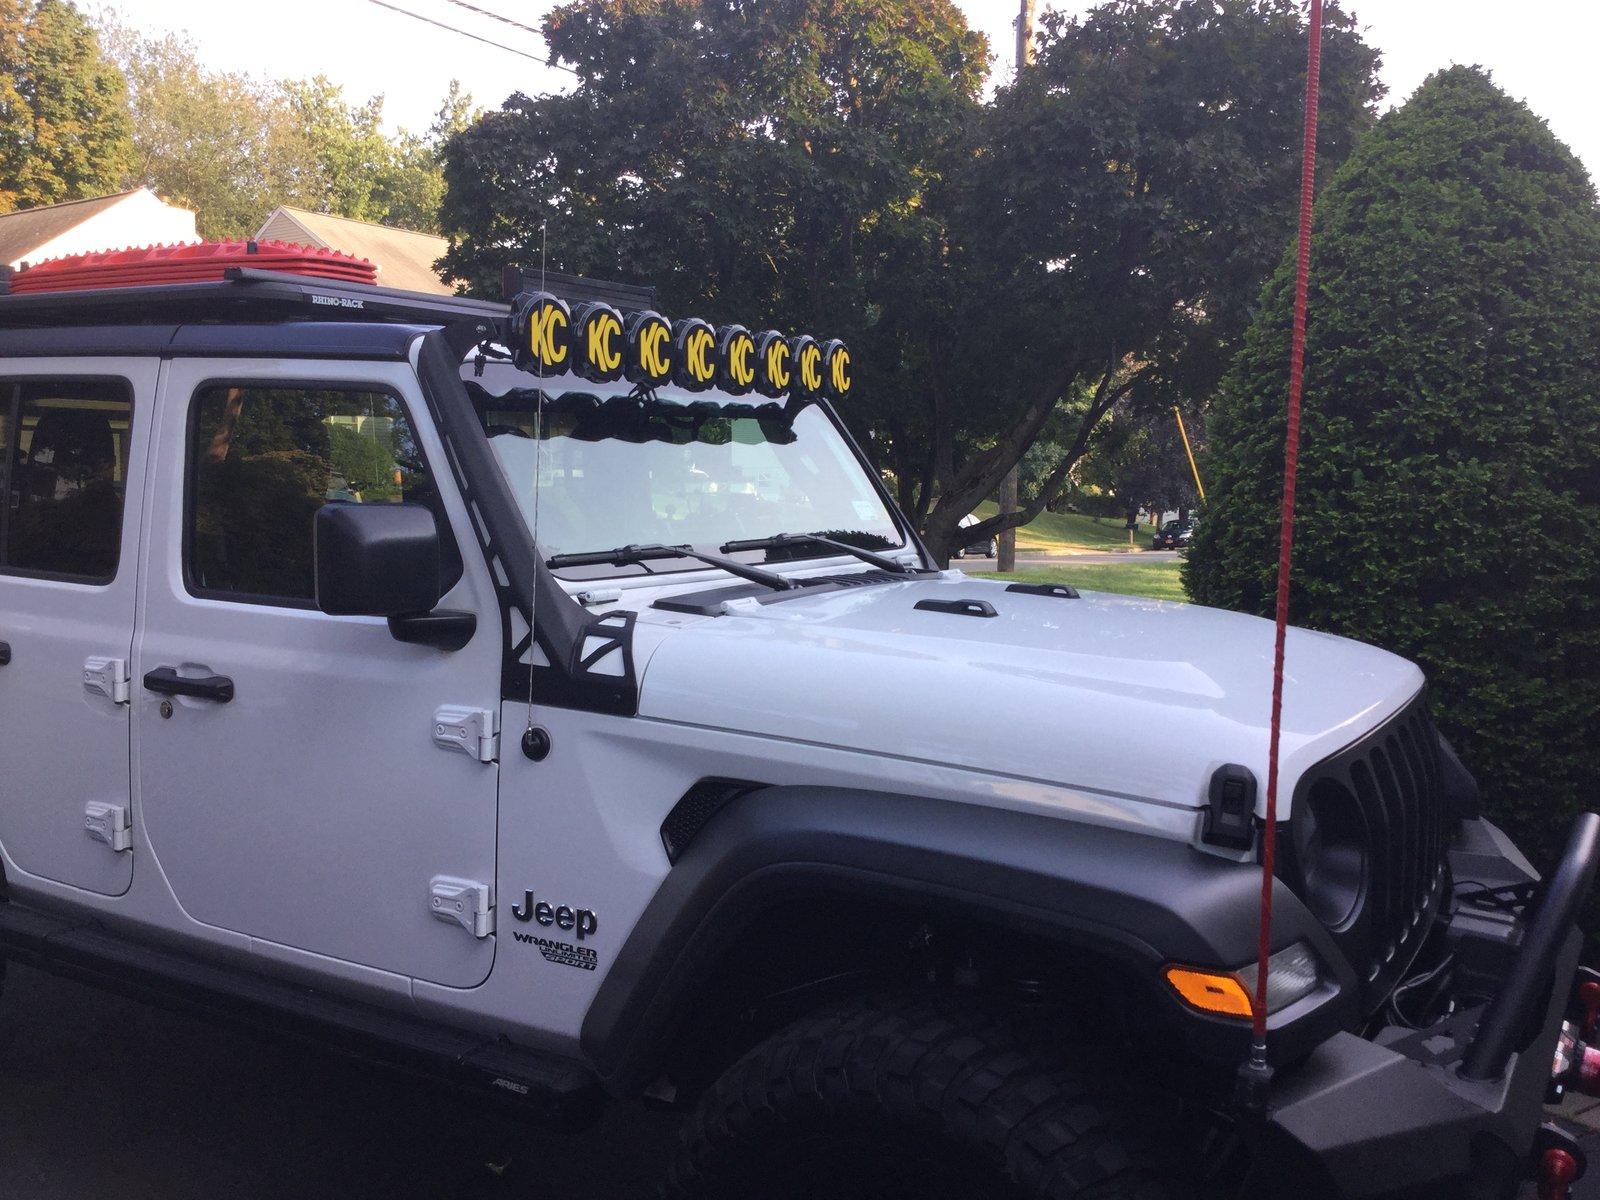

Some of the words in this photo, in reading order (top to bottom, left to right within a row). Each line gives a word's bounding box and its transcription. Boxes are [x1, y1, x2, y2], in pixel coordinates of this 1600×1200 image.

[312, 295, 364, 309] RHINO-RACK
[531, 304, 567, 366] KC
[588, 314, 621, 372] KC
[640, 322, 670, 378] KC
[687, 329, 715, 382] KC
[730, 335, 755, 386] KC
[768, 340, 790, 389] KC
[801, 344, 822, 392] KC
[832, 348, 850, 393] KC
[511, 888, 598, 941] Jeep
[513, 931, 597, 958] WRANGLER
[539, 946, 598, 962] UNLIMITED
[542, 951, 597, 971] SPORT
